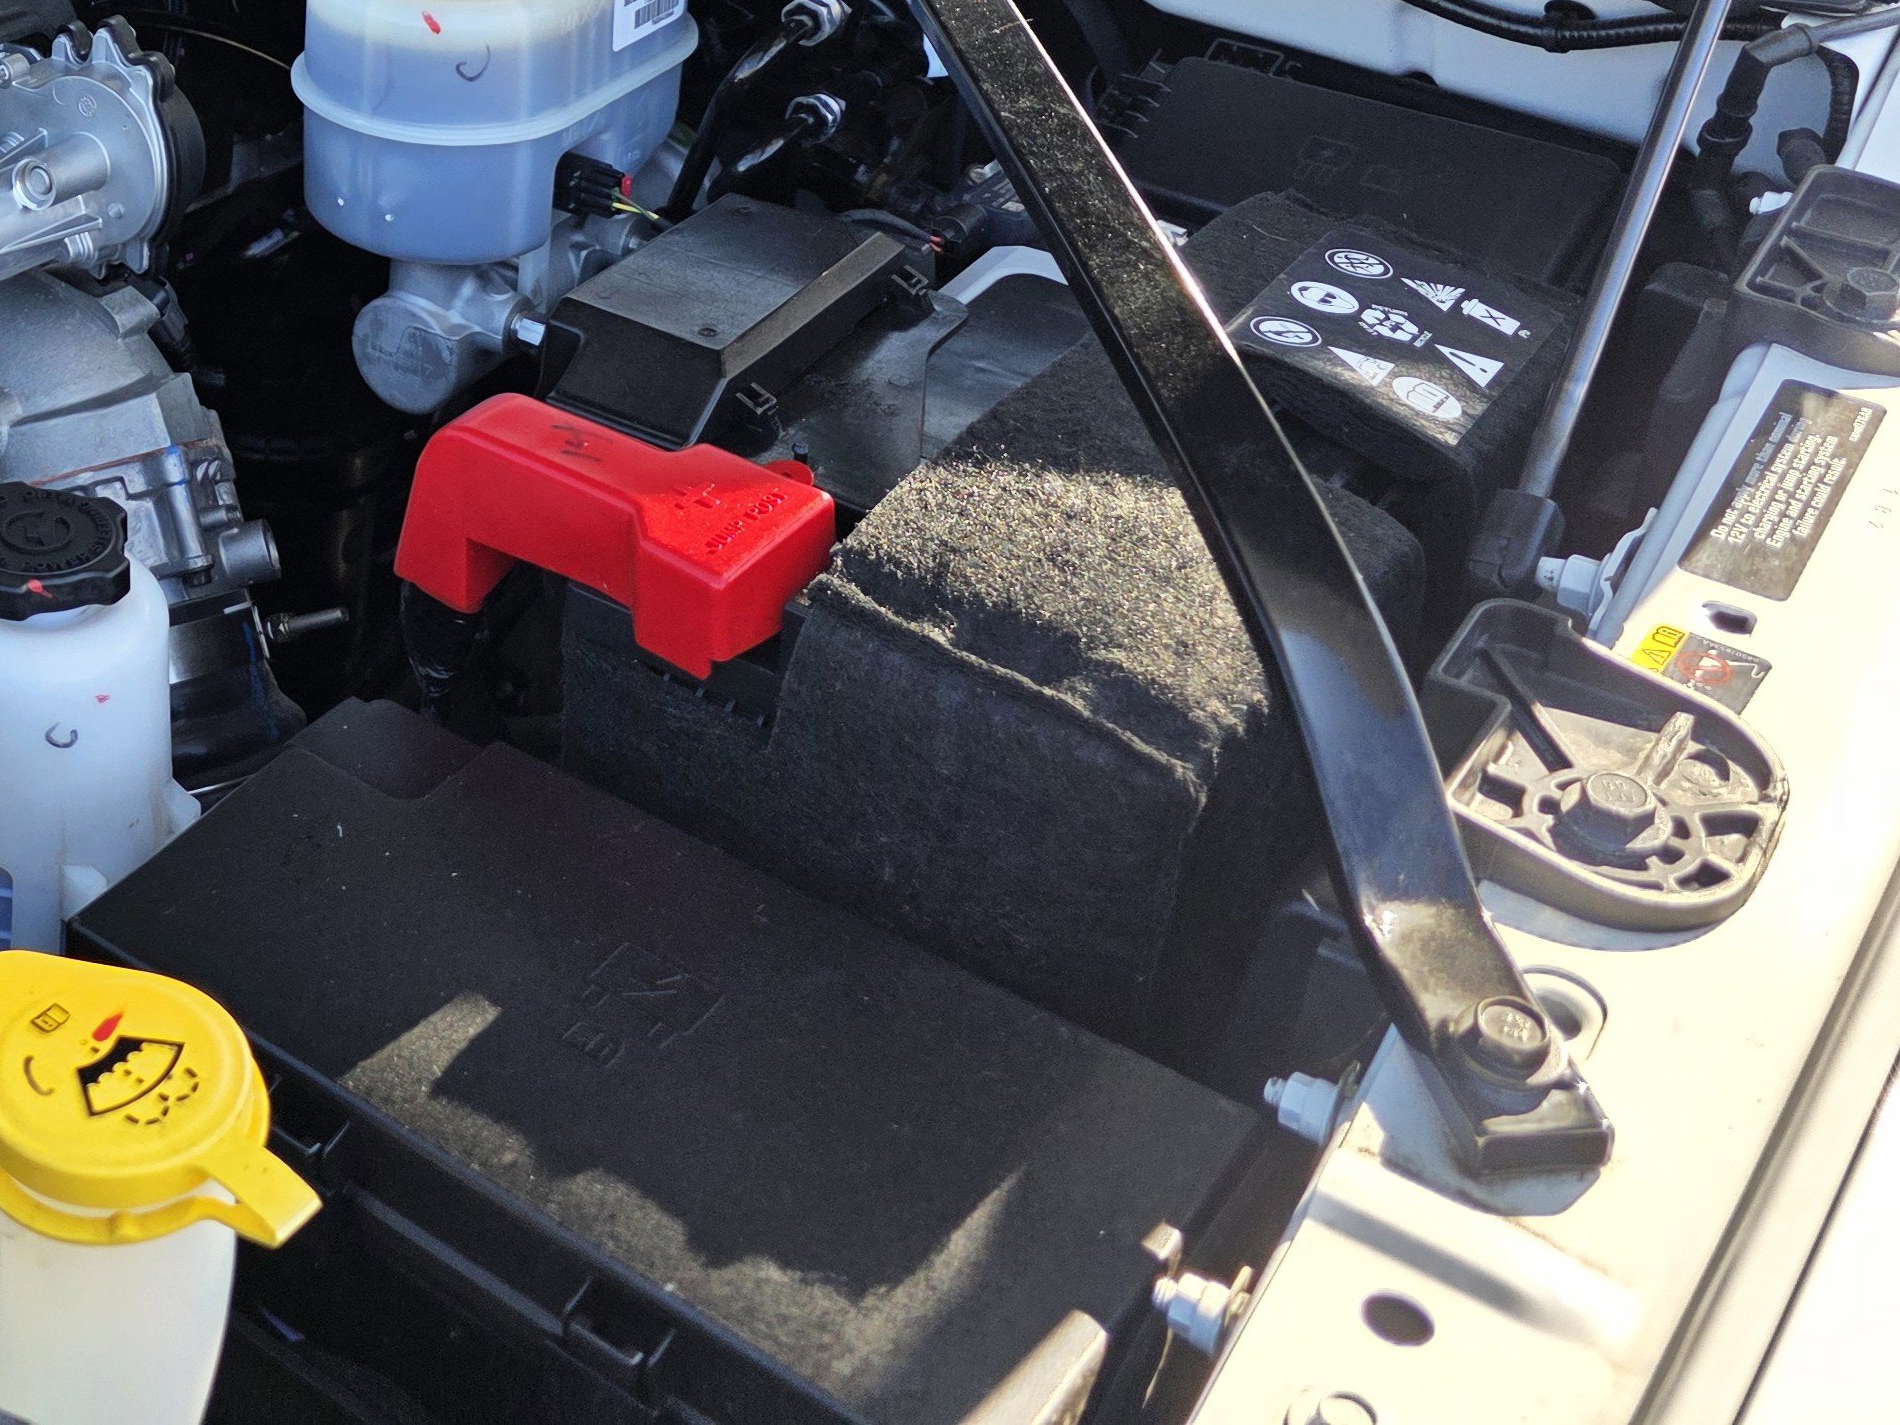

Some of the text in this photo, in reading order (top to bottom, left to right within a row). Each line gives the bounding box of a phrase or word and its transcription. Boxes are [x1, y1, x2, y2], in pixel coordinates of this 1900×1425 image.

[1710, 525, 1728, 541] Do
[1722, 508, 1739, 529] not
[1731, 484, 1754, 511] apply
[1727, 523, 1749, 545] 12V
[1747, 471, 1781, 514] electrical
[1771, 443, 1797, 474] system
[1754, 498, 1788, 540] charging
[1778, 469, 1801, 492] jump
[1765, 435, 1839, 549] Engine and starting system
[1792, 506, 1820, 538] failure
[1810, 482, 1833, 508] could
